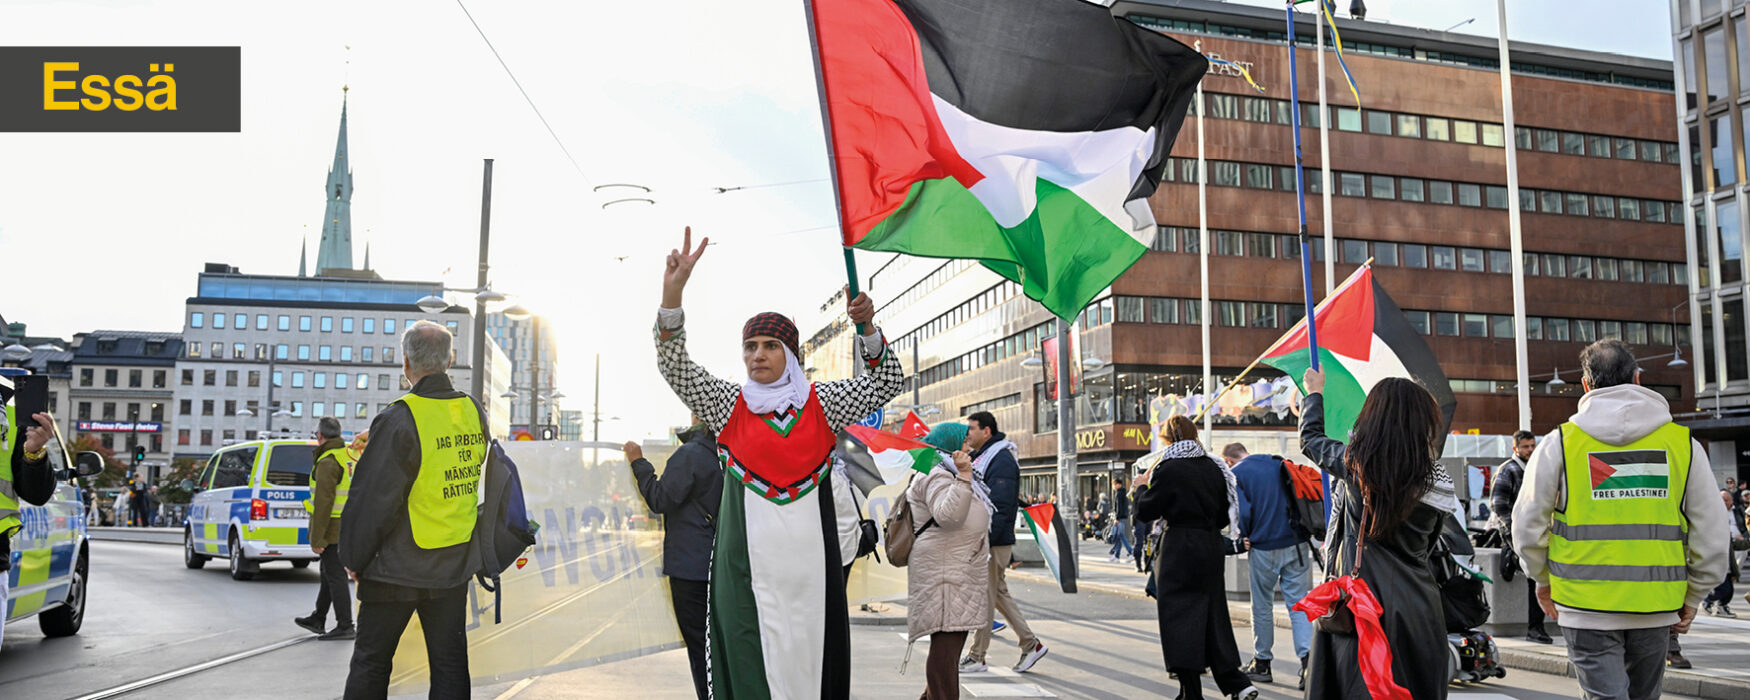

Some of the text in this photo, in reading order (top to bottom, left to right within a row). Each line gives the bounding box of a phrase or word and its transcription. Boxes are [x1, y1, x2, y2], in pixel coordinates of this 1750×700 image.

[436, 436, 451, 450] JAG
[267, 491, 295, 499] POLIS
[1593, 489, 1667, 498] FREE PALESTINE!
